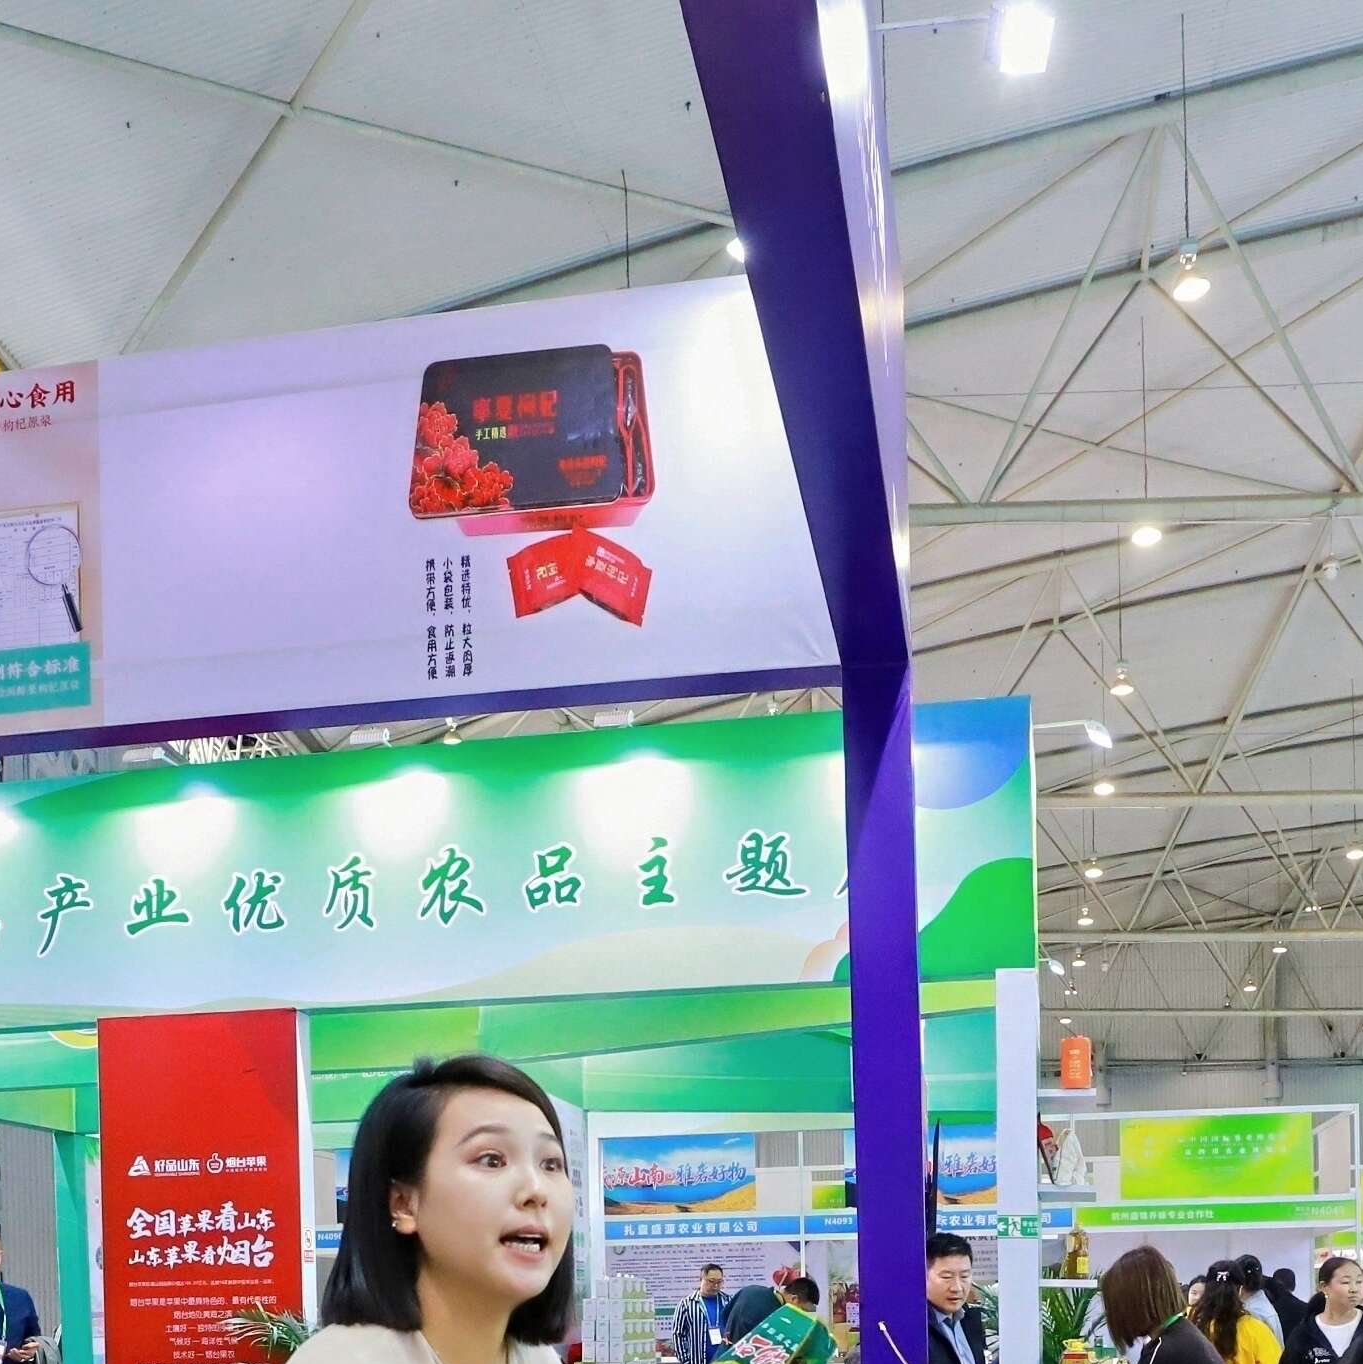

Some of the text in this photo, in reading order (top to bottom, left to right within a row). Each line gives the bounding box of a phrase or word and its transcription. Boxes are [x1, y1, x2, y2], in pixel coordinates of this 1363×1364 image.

[154, 1159, 200, 1172] 好品山东
[225, 1155, 267, 1167] 烟台苹果
[126, 1201, 275, 1239] 全国苹果看山东
[824, 1217, 853, 1226] N4093
[128, 1234, 274, 1269] 山东苹果看烟台
